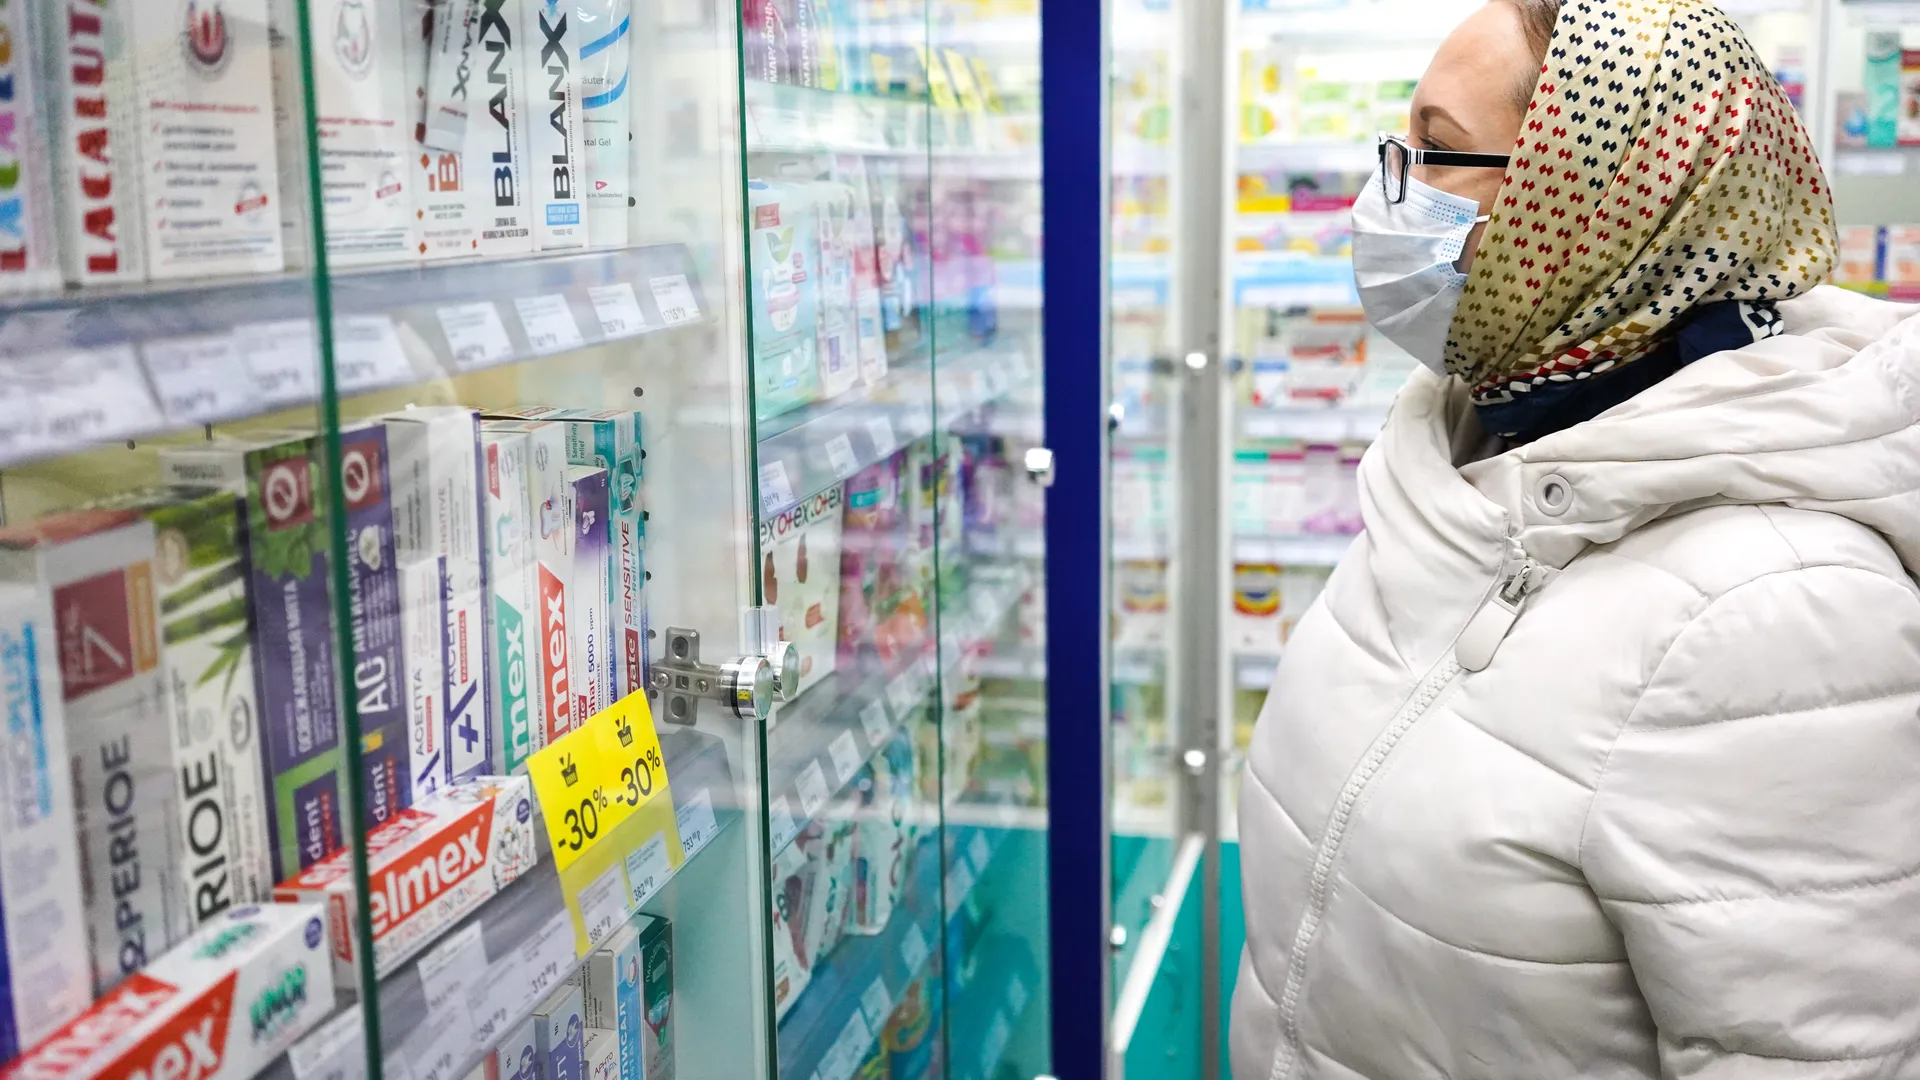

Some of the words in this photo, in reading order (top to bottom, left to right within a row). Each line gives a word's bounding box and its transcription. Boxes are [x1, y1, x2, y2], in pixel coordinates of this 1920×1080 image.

[538, 9, 570, 199] BLANX
[598, 138, 612, 147] Gel
[622, 520, 632, 625] SENSITIVE
[505, 620, 529, 766] mex
[547, 588, 571, 746] mex
[587, 633, 596, 673] 5000
[627, 636, 639, 694] gate
[558, 785, 608, 851] -30%
[616, 746, 660, 807] -30%
[182, 752, 231, 921] RIOE
[370, 825, 484, 935] elmex
